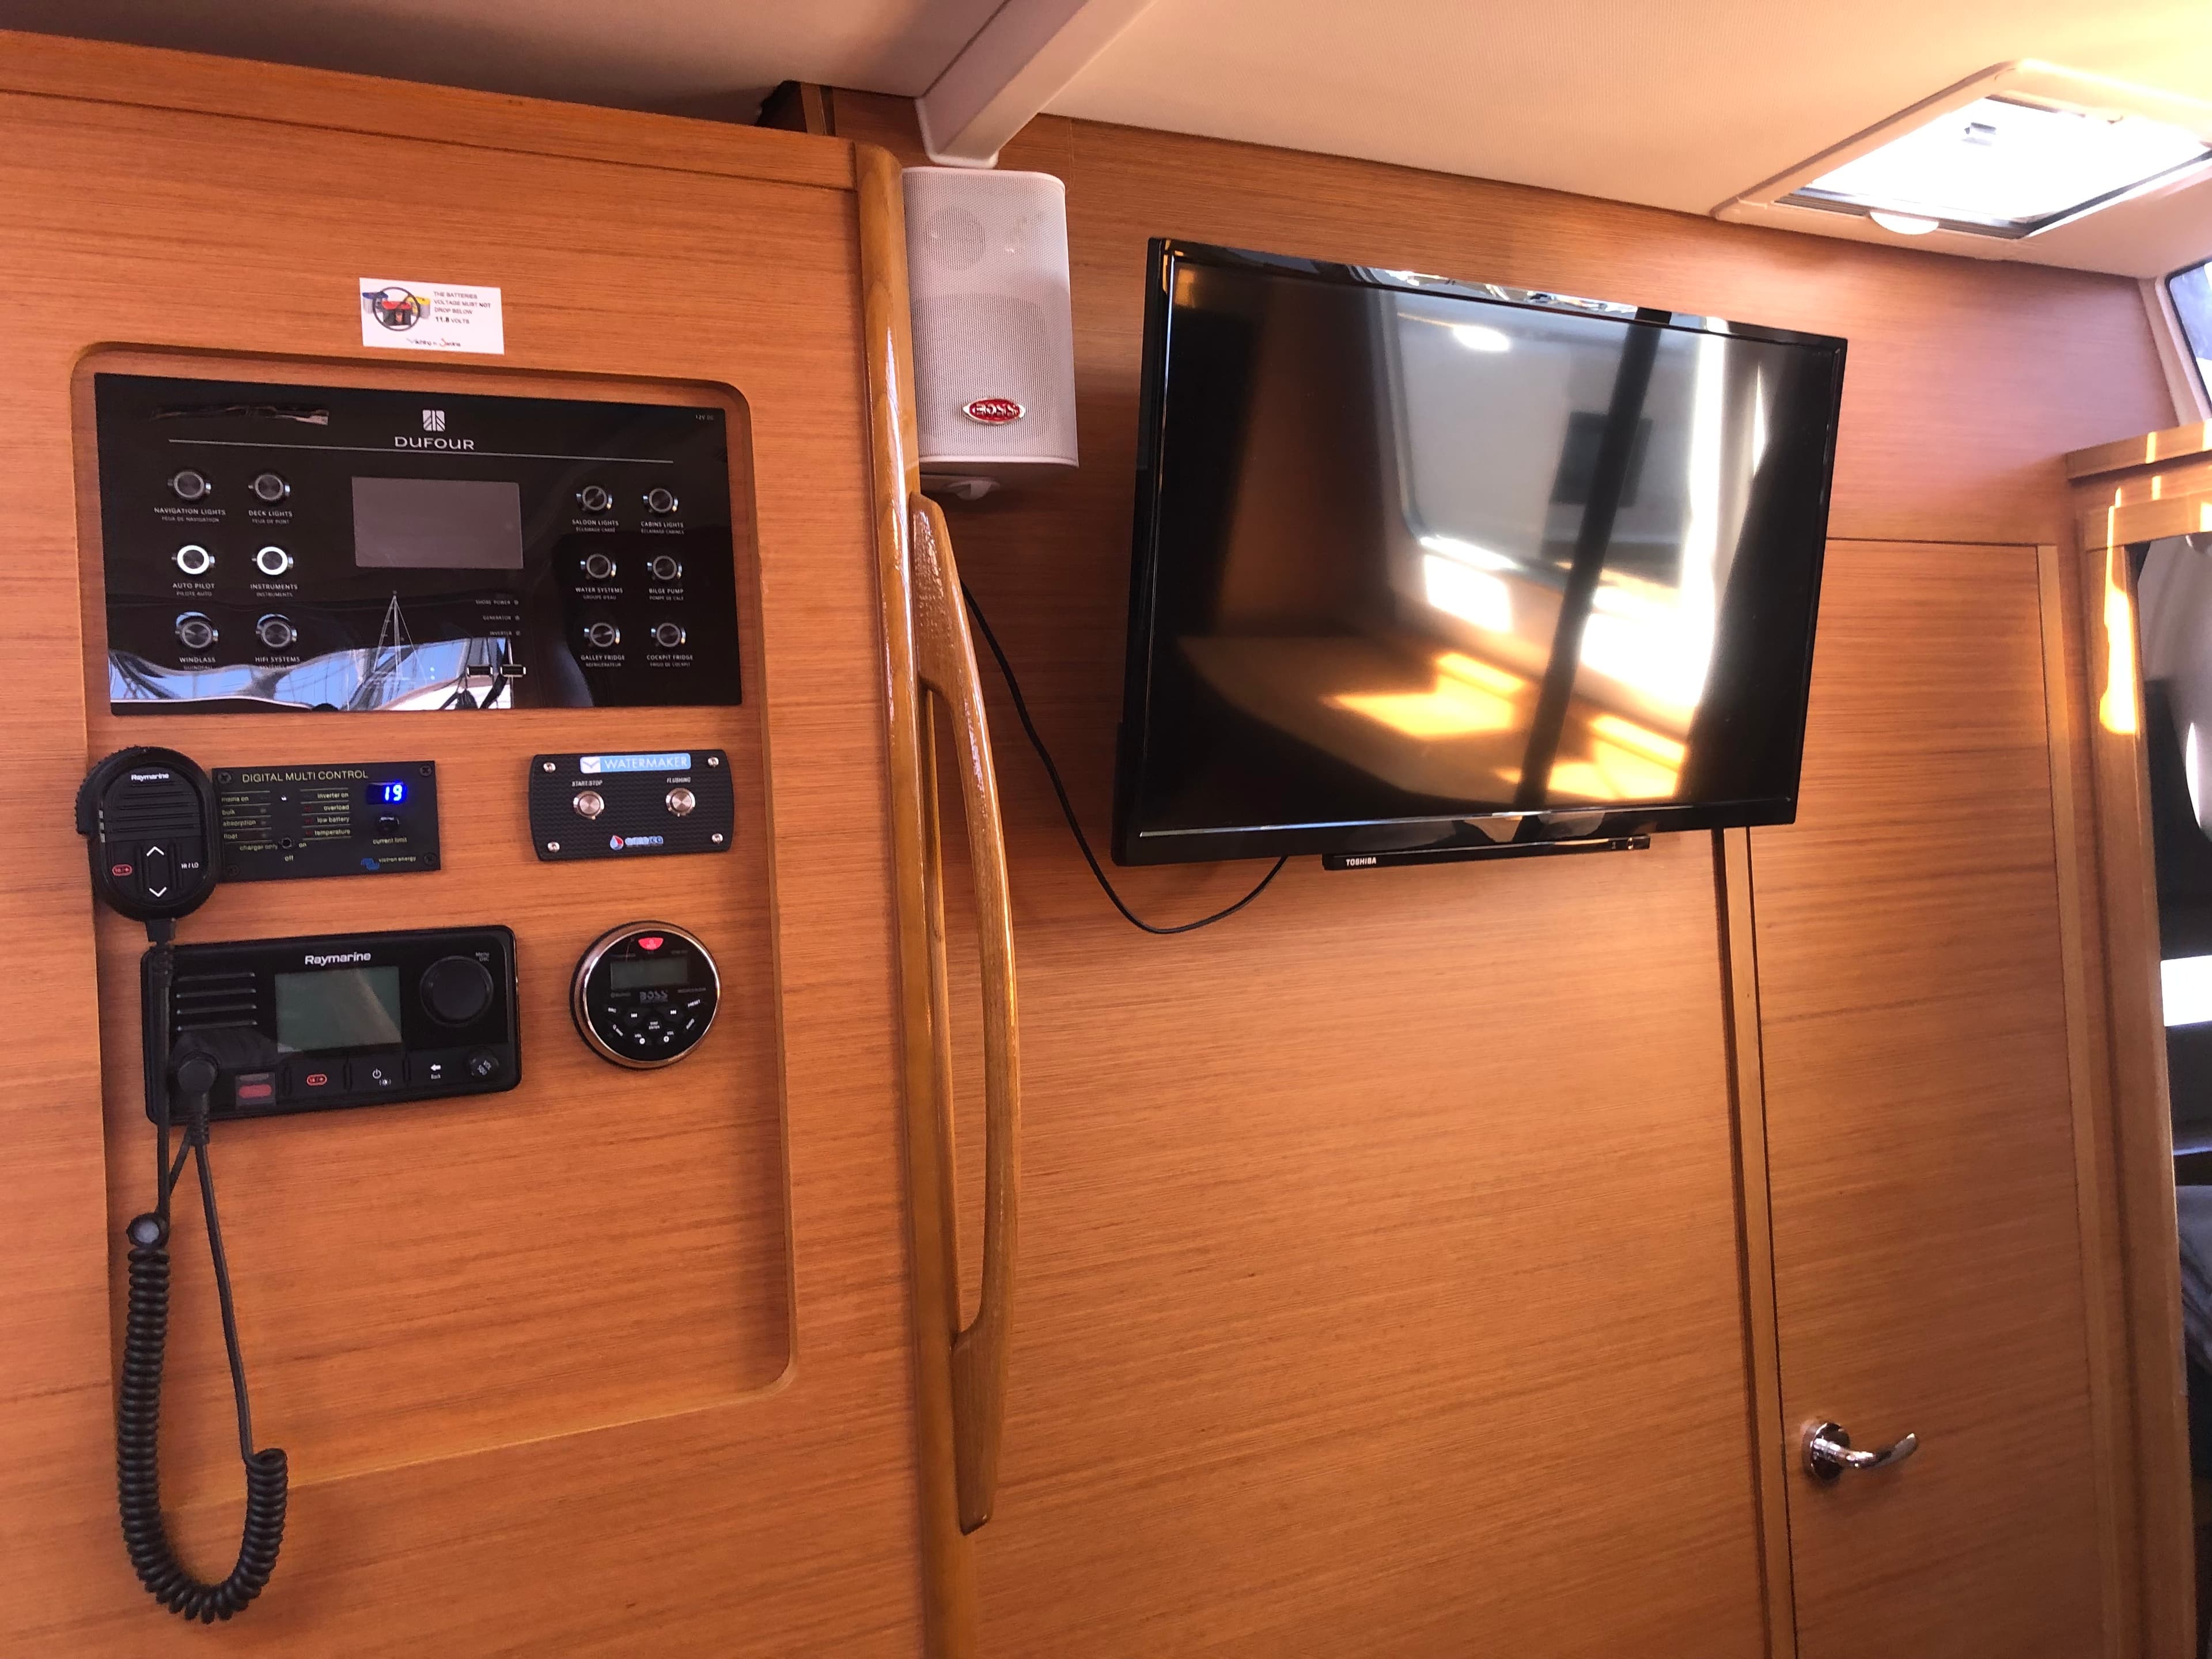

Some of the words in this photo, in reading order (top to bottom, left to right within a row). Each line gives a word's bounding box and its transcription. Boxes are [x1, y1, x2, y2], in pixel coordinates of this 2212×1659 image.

[395, 436, 475, 450] DUFOUR
[154, 507, 199, 515] NAVIGATION
[604, 756, 687, 770] WATERMAKER
[131, 772, 169, 782] Raymarine
[242, 772, 283, 783] DIGITAL
[285, 771, 316, 782] MULTI
[317, 770, 369, 780] CONTROL
[384, 784, 403, 801] 19
[222, 820, 256, 828] absorption
[1346, 857, 1377, 866] TOSHIBA
[305, 951, 371, 967] Raymarine
